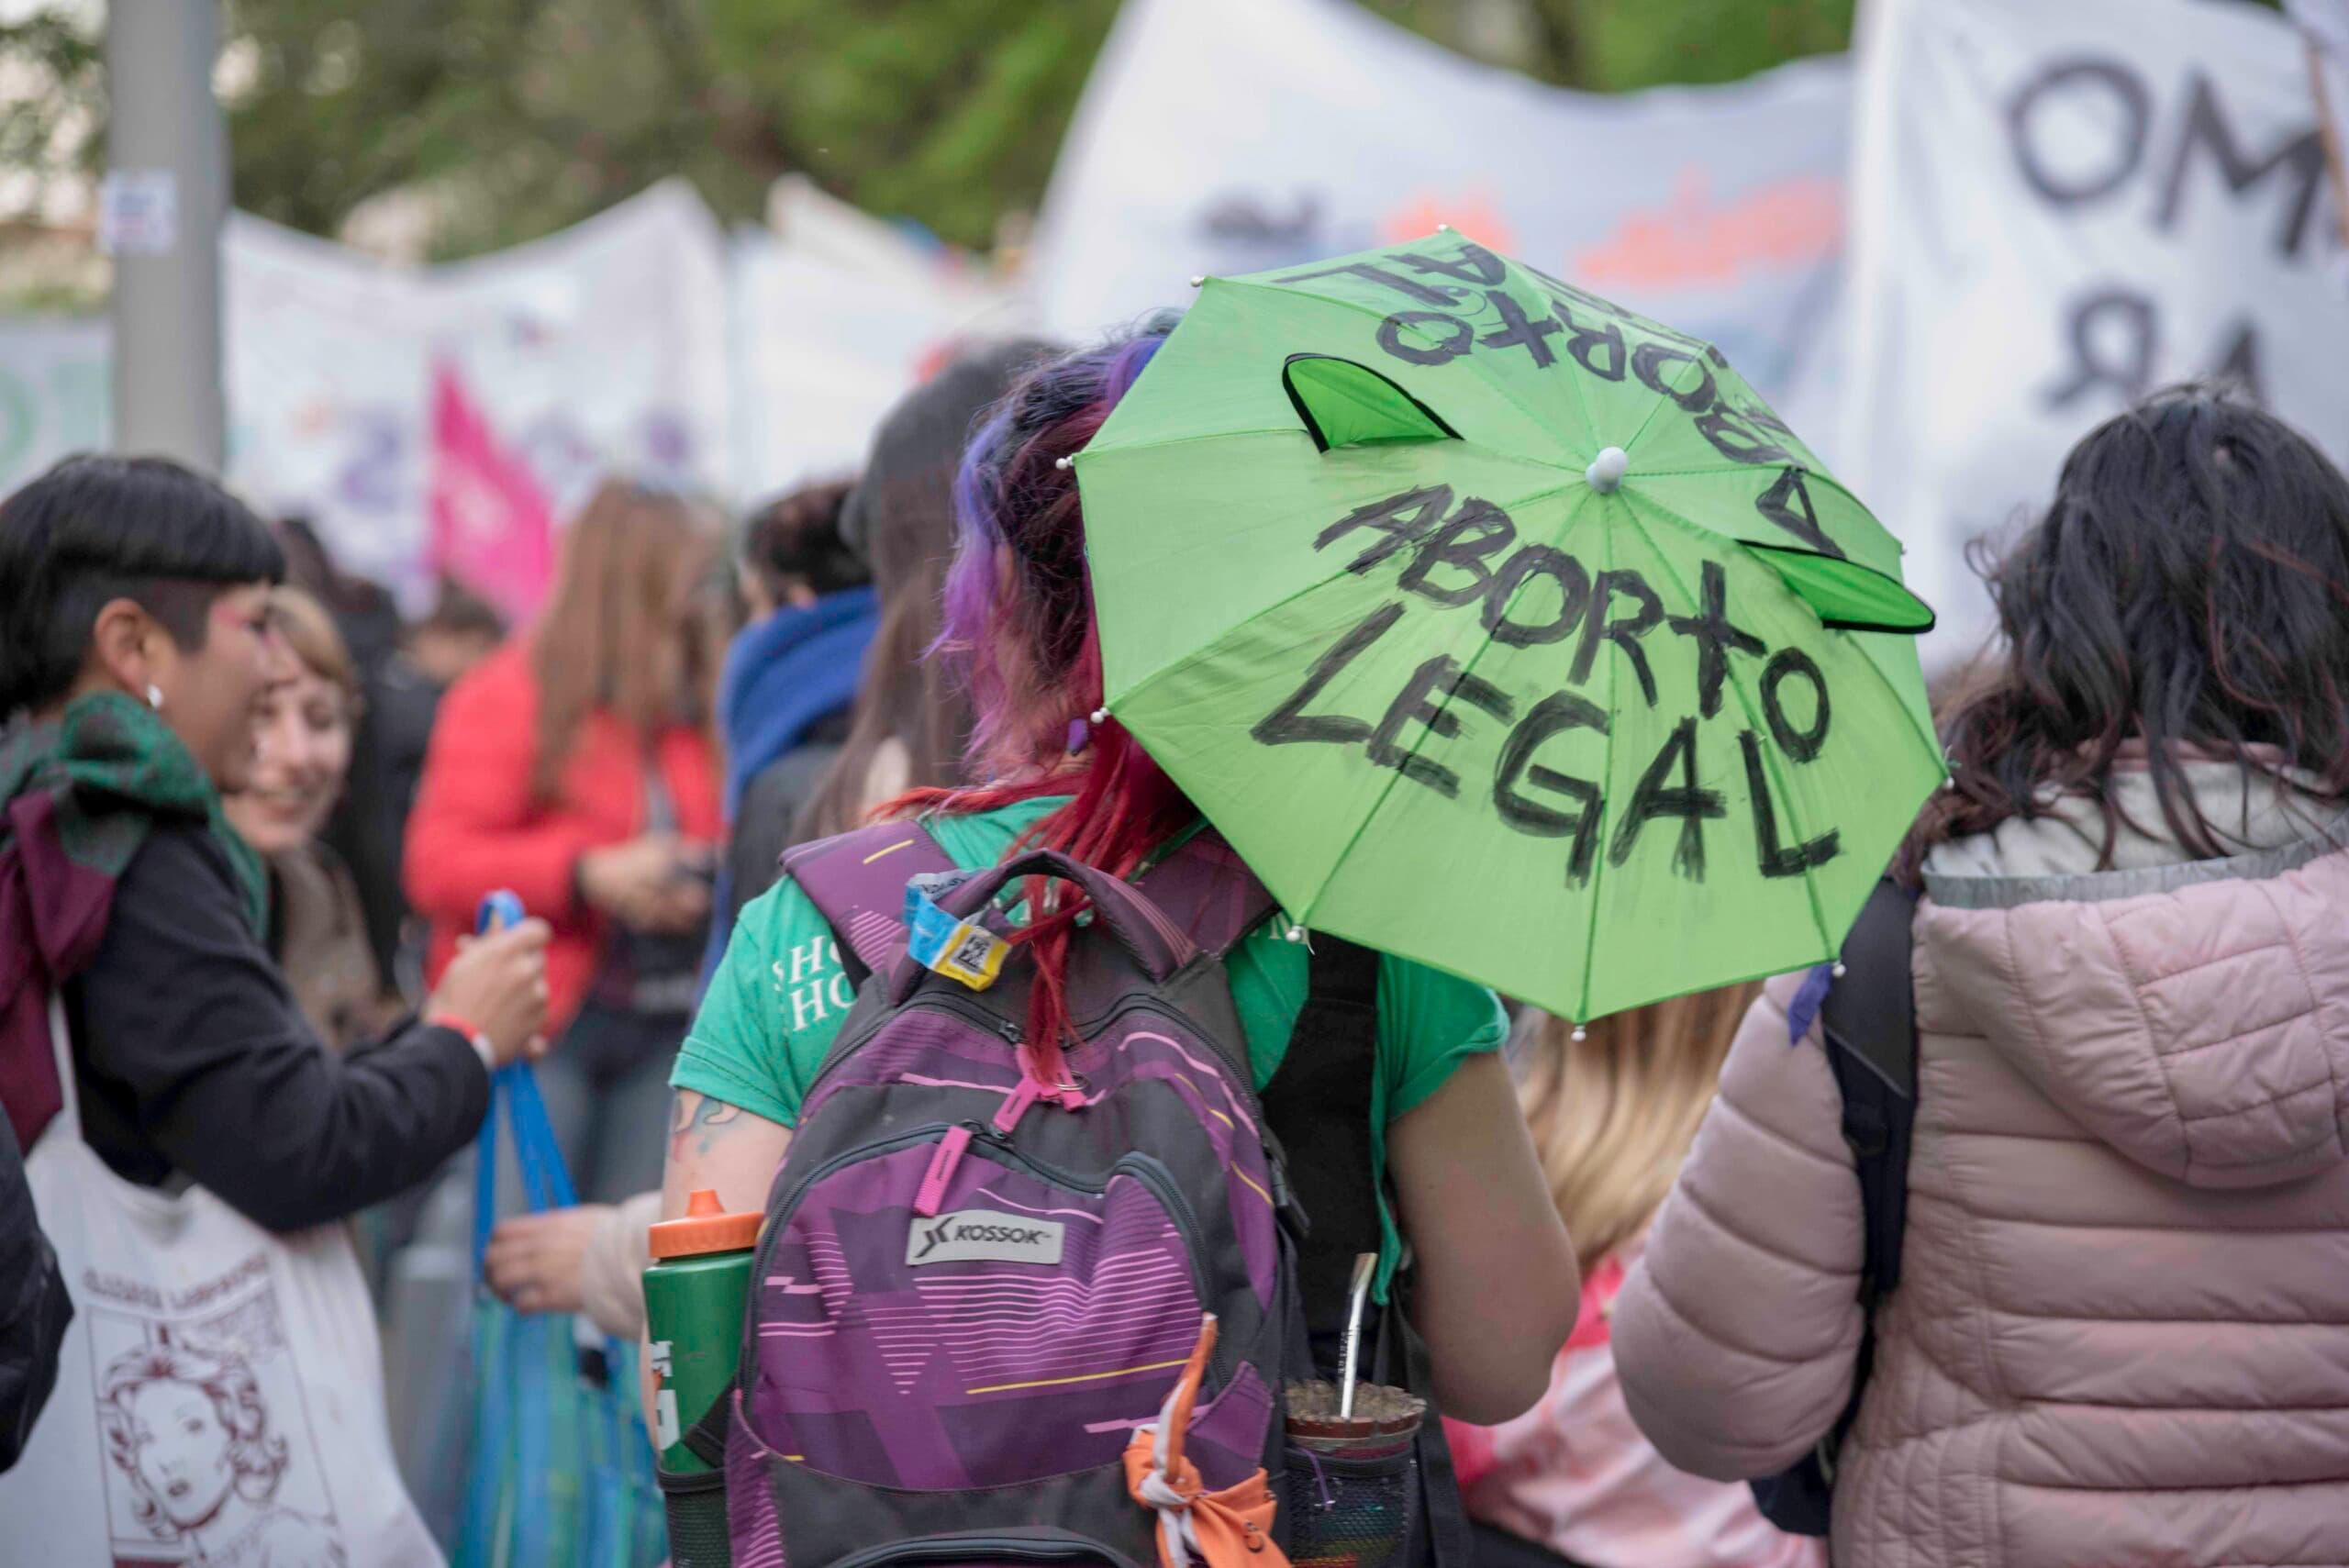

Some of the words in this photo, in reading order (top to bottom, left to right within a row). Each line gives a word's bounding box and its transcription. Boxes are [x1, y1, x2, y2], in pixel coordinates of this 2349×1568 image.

[1250, 601, 1842, 890] LEGAL
[1313, 483, 1831, 765] ABORTO
[953, 1223, 1043, 1245] KOSSOK
